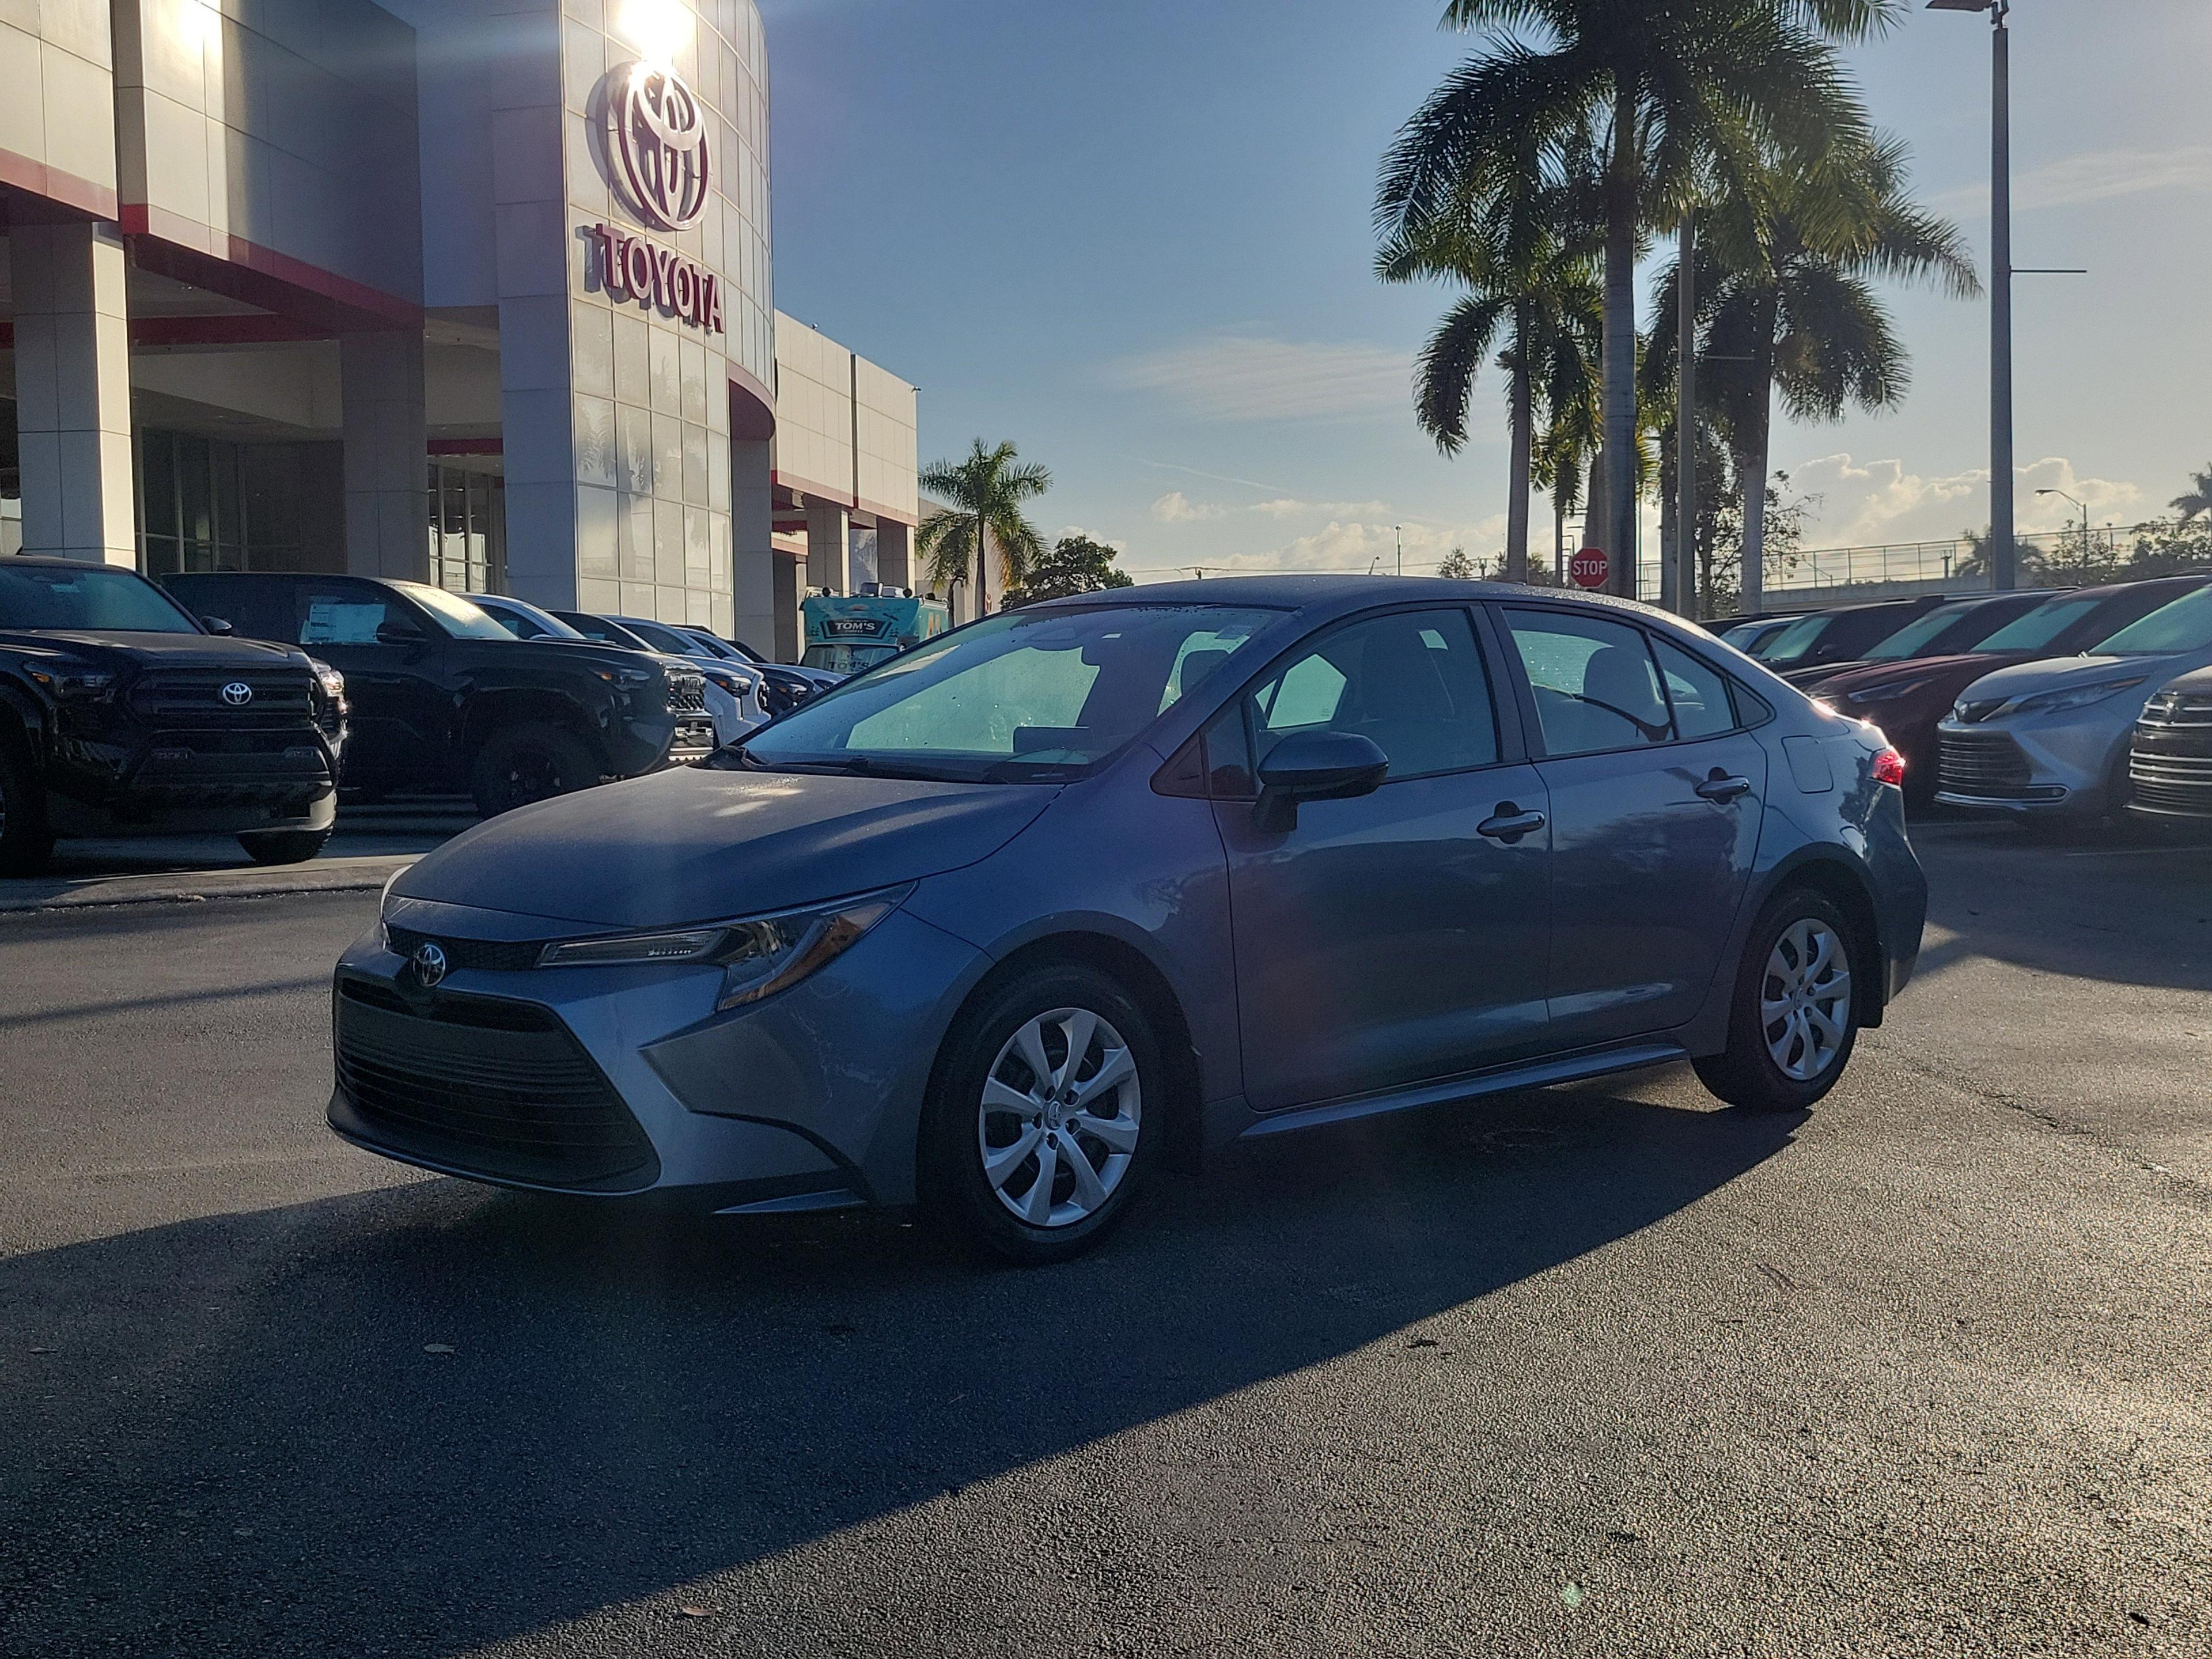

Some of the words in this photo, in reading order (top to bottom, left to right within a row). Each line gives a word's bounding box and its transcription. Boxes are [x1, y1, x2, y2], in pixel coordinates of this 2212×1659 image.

[596, 223, 725, 334] TOYOTA
[1573, 560, 1607, 575] STOP
[835, 622, 876, 630] TOM'S
